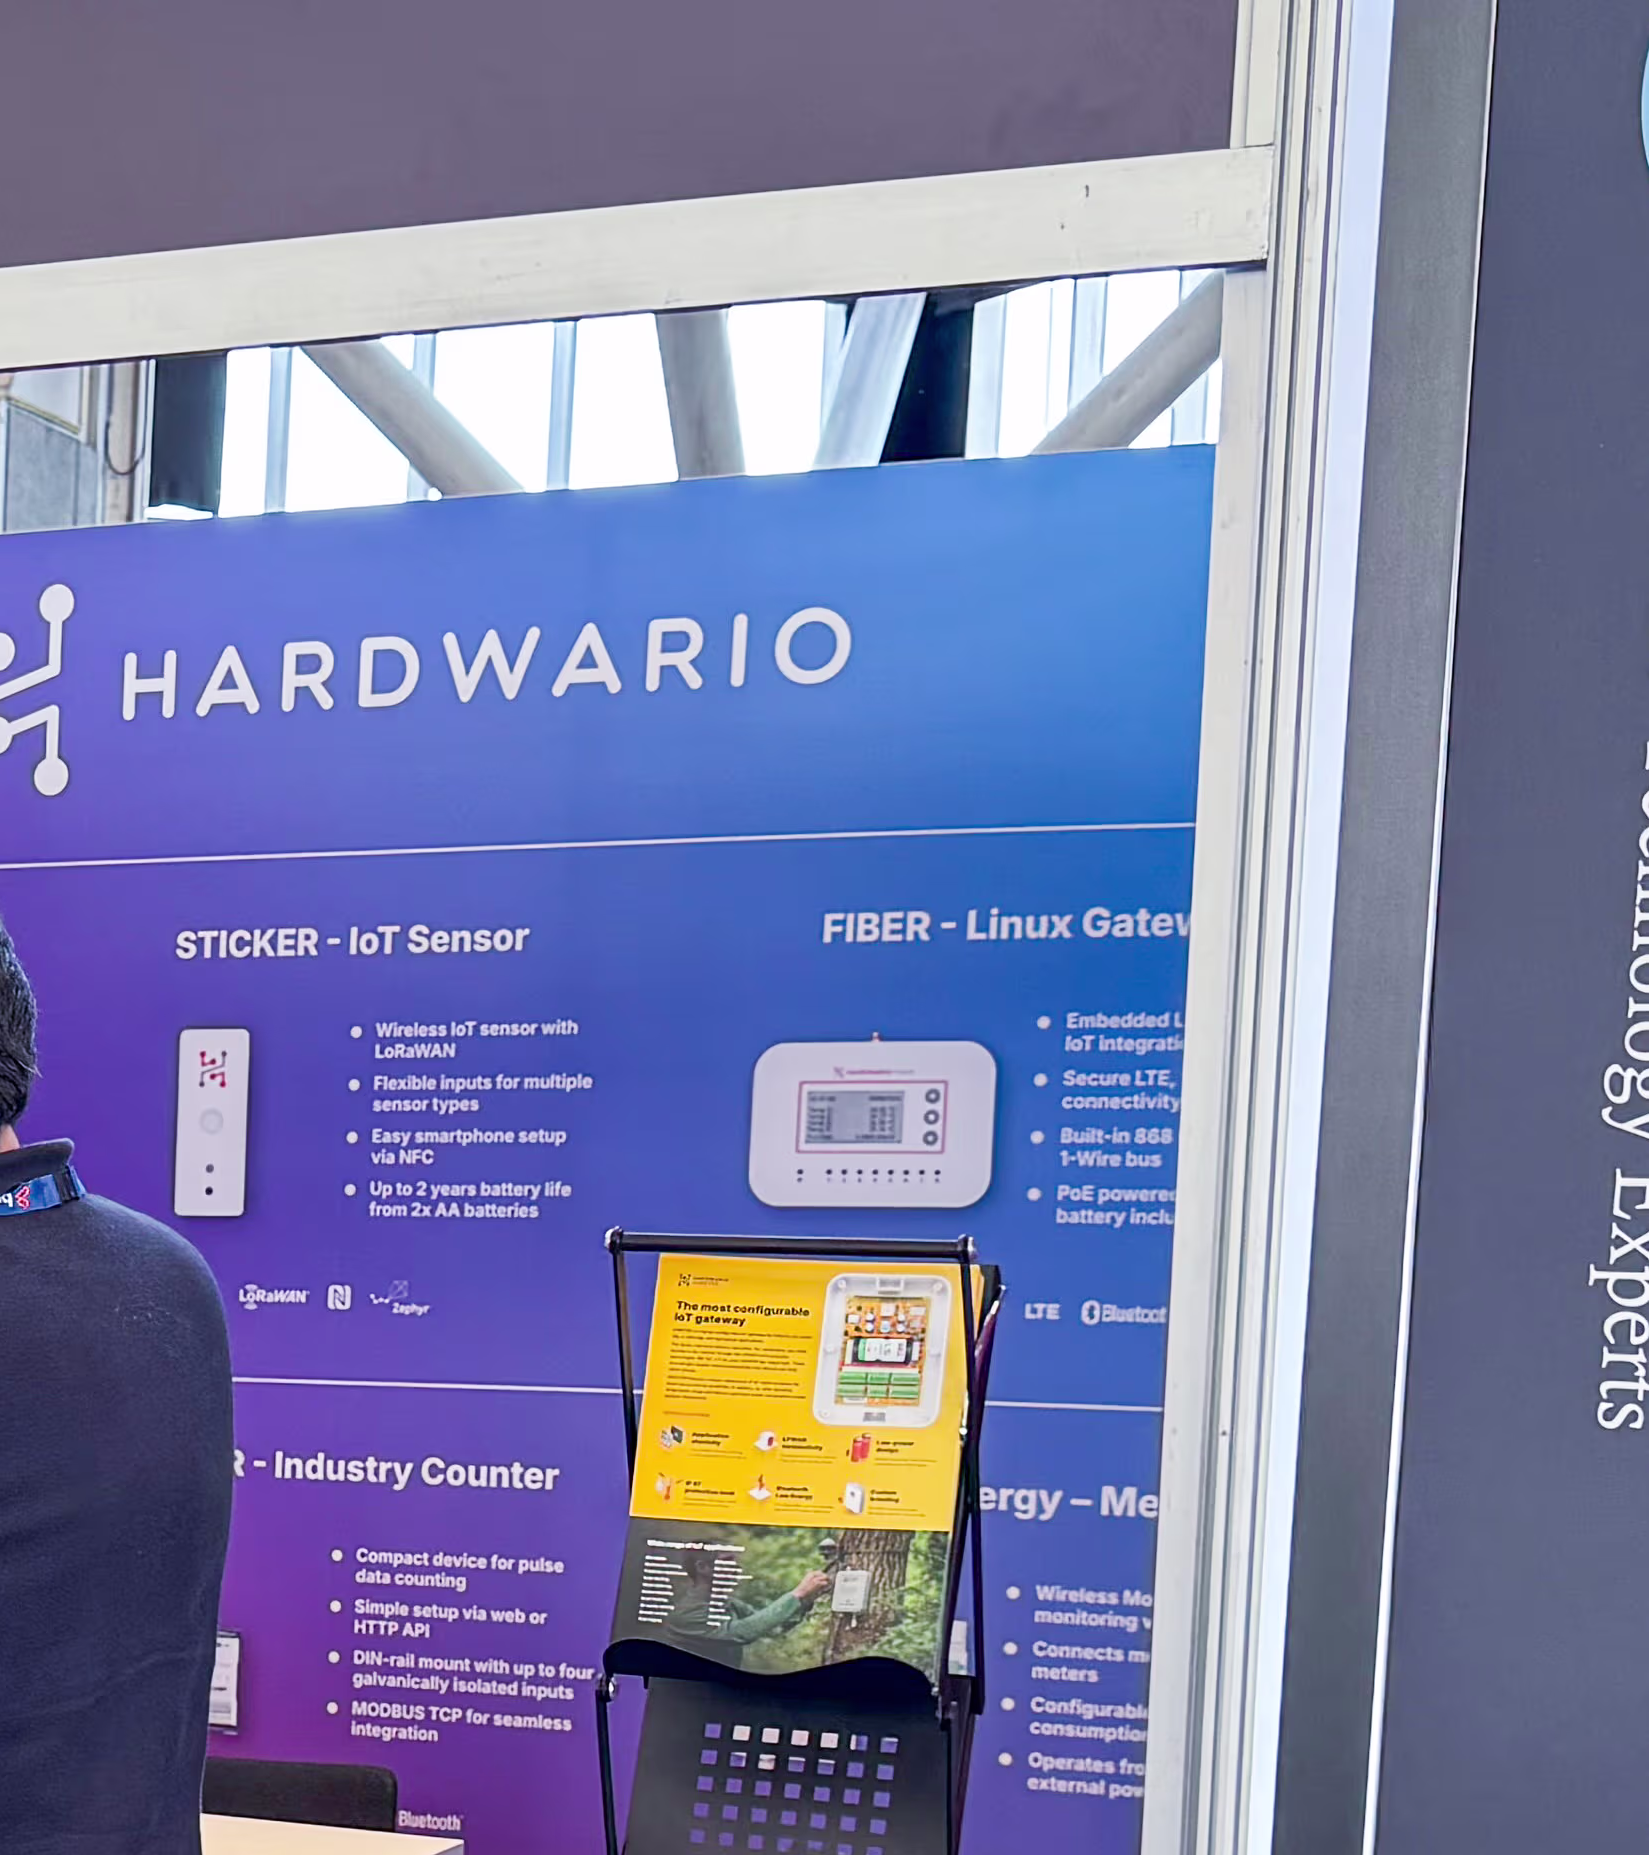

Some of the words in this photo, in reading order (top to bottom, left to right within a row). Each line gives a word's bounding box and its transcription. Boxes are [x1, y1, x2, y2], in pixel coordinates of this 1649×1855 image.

[123, 607, 854, 722] HARDWARIO
[823, 911, 930, 944] FIBER
[967, 909, 1072, 941] Linux
[176, 928, 318, 959] STICKER
[350, 926, 400, 955] IoT
[408, 924, 529, 954] Sensor
[376, 1021, 447, 1038] Wireless
[451, 1021, 476, 1036] IoT
[481, 1022, 538, 1036] sensor
[542, 1020, 578, 1035] with
[1066, 1013, 1170, 1030] Embedded
[376, 1043, 456, 1059] LoRaWAN
[1066, 1035, 1094, 1051] IoT
[373, 1075, 436, 1091] Flexible
[441, 1075, 492, 1092] inputs
[497, 1075, 520, 1090] for
[525, 1073, 592, 1090] multiple
[1063, 1070, 1130, 1087] Secure
[1135, 1070, 1176, 1089] LTE,
[373, 1098, 428, 1112] sensor
[433, 1097, 479, 1114] types
[372, 1128, 411, 1147] Easy
[415, 1127, 514, 1146] smartphone
[518, 1128, 566, 1146] setup
[1060, 1128, 1130, 1144] Built-in
[1135, 1128, 1173, 1144] 868
[371, 1150, 394, 1165] via
[399, 1149, 434, 1165] NFC
[1060, 1151, 1120, 1167] 1-Wire
[1125, 1151, 1162, 1168] bus
[370, 1182, 393, 1199] Up
[397, 1183, 411, 1196] to
[417, 1182, 427, 1196] 2
[431, 1184, 477, 1200] years
[482, 1182, 541, 1200] battery
[546, 1181, 571, 1196] life
[1057, 1186, 1093, 1202] PoE
[369, 1202, 407, 1218] from
[412, 1203, 431, 1218] 2x
[436, 1203, 460, 1217] AA
[464, 1202, 539, 1218] batteries
[1056, 1208, 1124, 1227] battery
[676, 1301, 698, 1310] The
[701, 1304, 731, 1312] most
[733, 1305, 810, 1316] configurable
[1588, 1166, 1649, 1432] Experts
[675, 1313, 692, 1321] IoT
[696, 1315, 746, 1326] gateway
[1025, 1303, 1060, 1319] LTE
[275, 1450, 413, 1491] Industry
[422, 1456, 559, 1491] Counter
[356, 1548, 429, 1568] Compact
[433, 1551, 487, 1569] device
[491, 1554, 515, 1570] for
[519, 1555, 564, 1575] pulse
[355, 1569, 391, 1585] data
[395, 1570, 467, 1592] counting
[1036, 1585, 1118, 1605] Wireless
[354, 1599, 409, 1619] Simple
[413, 1604, 458, 1622] setup
[463, 1606, 490, 1622] via
[495, 1607, 525, 1624] web
[530, 1610, 547, 1625] or
[1035, 1608, 1136, 1631] monitoring
[354, 1621, 399, 1636] HTTP
[403, 1623, 430, 1638] API
[1033, 1641, 1124, 1662] Connects
[354, 1650, 414, 1669] DIN-rail
[419, 1653, 470, 1672] mount
[474, 1657, 510, 1675] with
[513, 1661, 534, 1679] up
[539, 1662, 555, 1678] to
[559, 1664, 594, 1680] four
[1032, 1664, 1098, 1682] meters
[353, 1671, 449, 1694] galvanically
[453, 1677, 518, 1696] isolated
[522, 1681, 574, 1701] inputs
[352, 1702, 424, 1720] MODBUS
[429, 1707, 462, 1723] TCP
[467, 1708, 490, 1725] for
[494, 1713, 572, 1731] seamless
[351, 1722, 438, 1742] integration
[1029, 1752, 1115, 1775] Operates
[1028, 1775, 1105, 1796] external
[399, 1810, 461, 1831] Bluetooth
